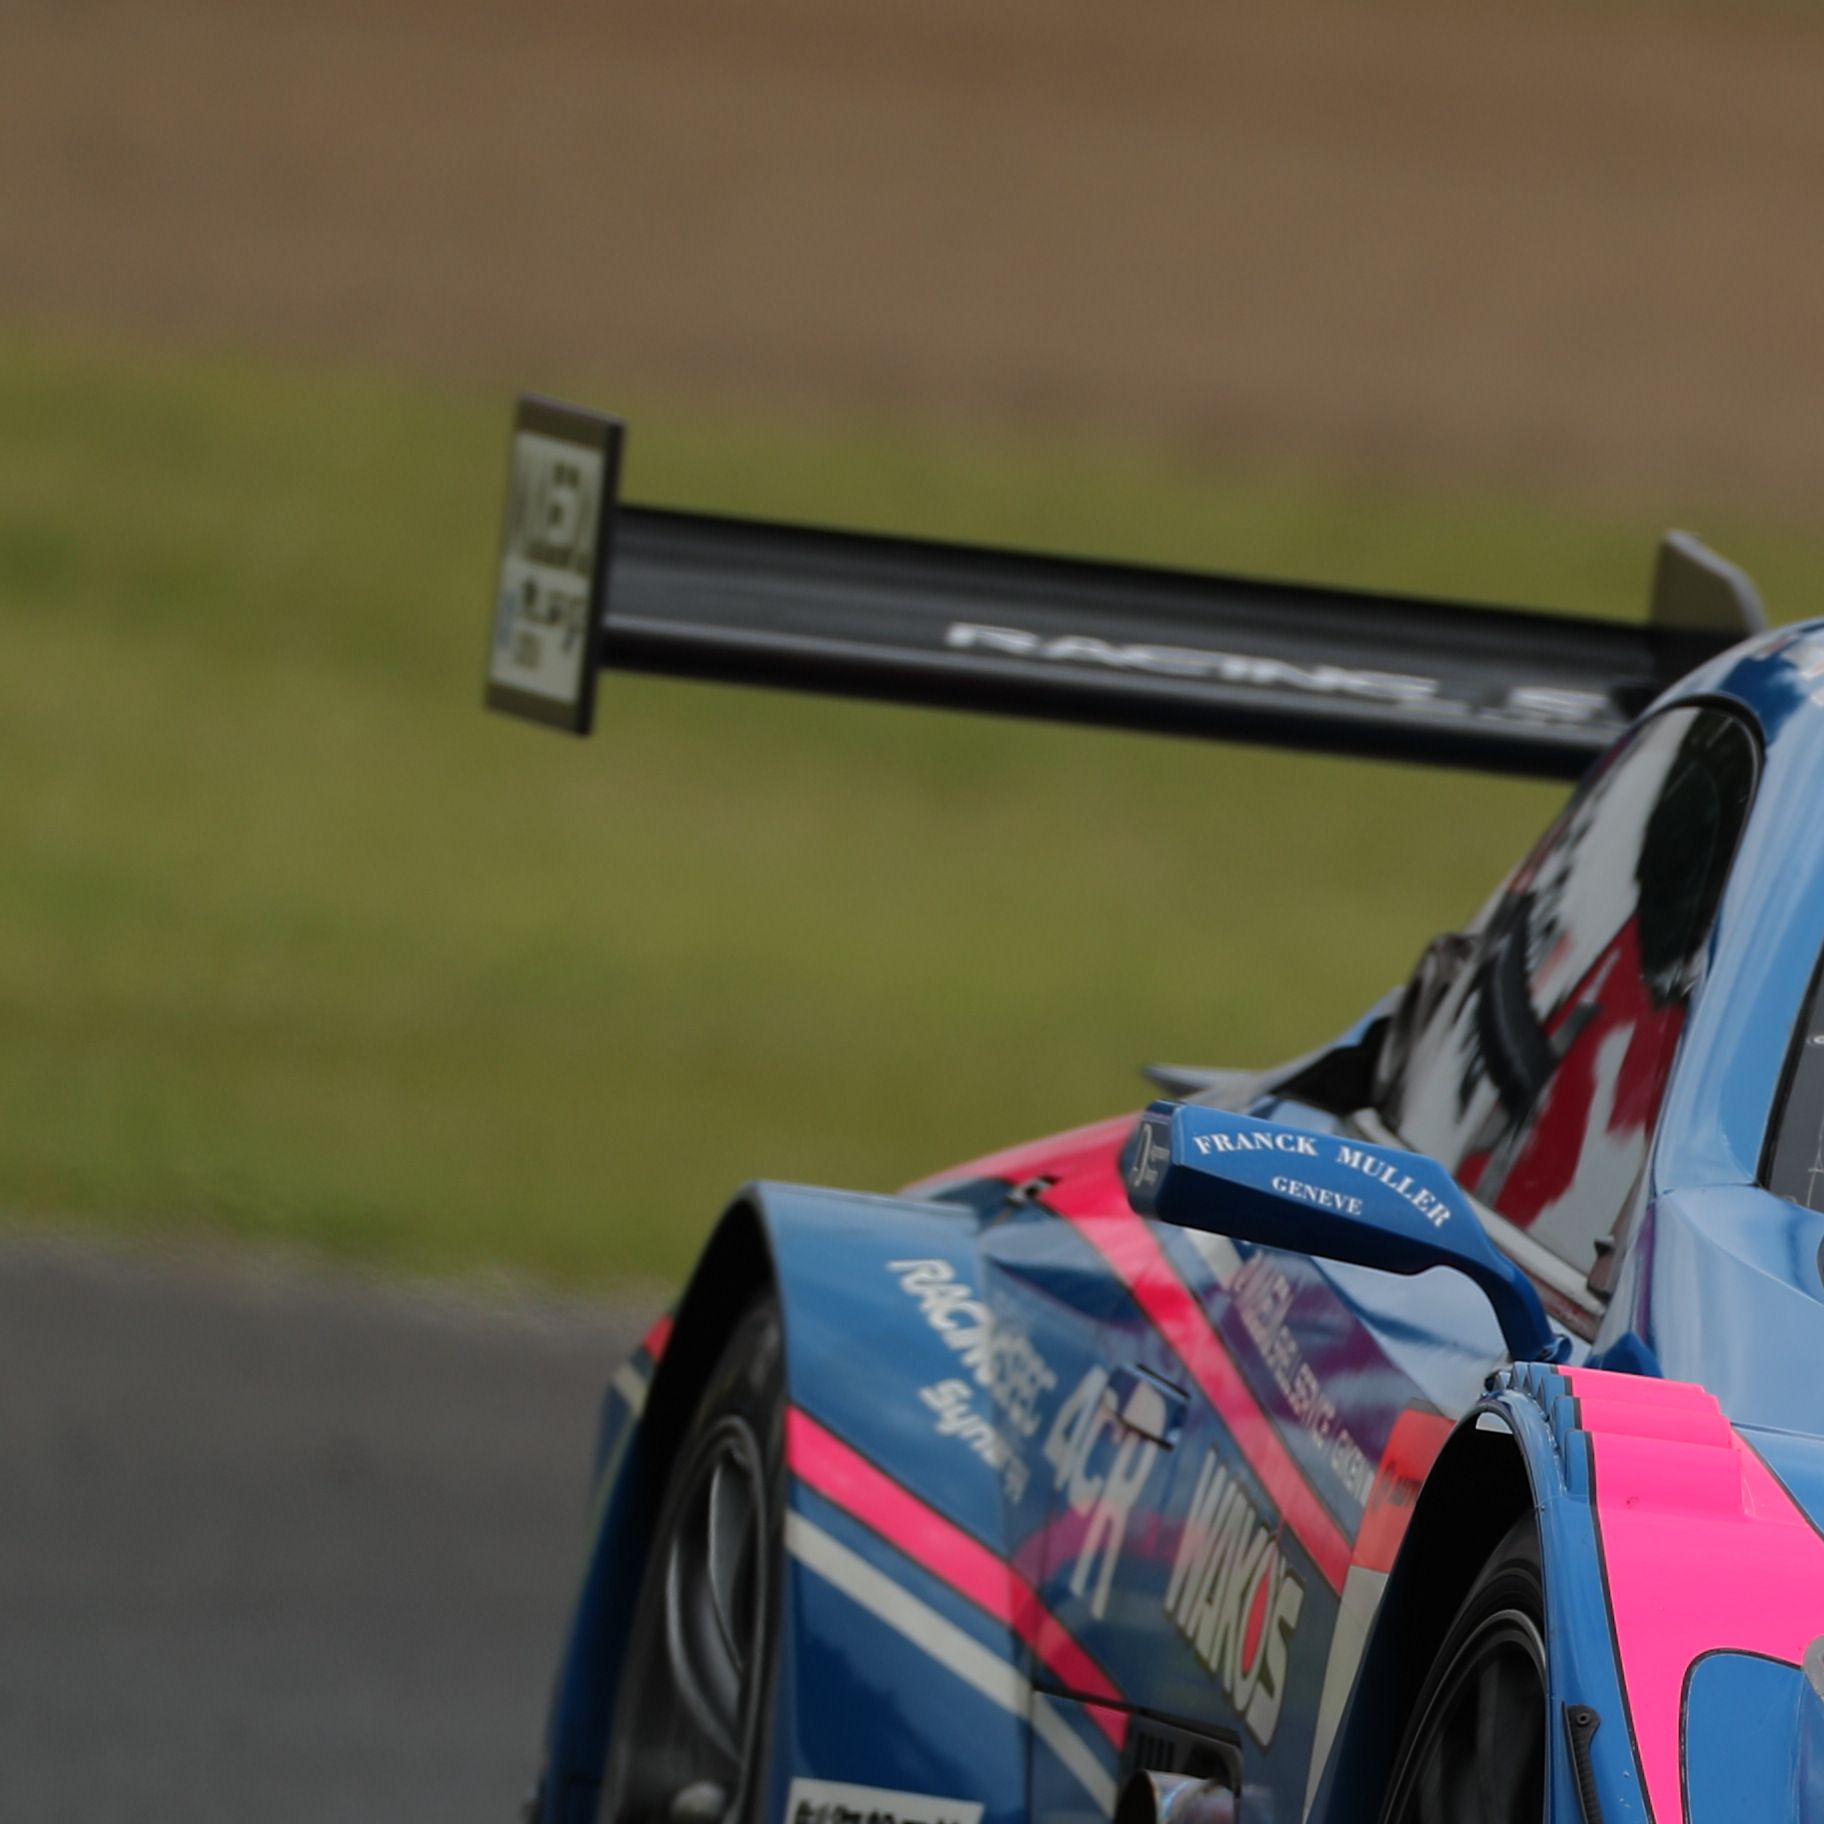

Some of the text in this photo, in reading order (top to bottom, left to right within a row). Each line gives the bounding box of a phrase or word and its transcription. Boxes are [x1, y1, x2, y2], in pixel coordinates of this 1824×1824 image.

[1192, 1131, 1319, 1157] FRANCK
[1335, 1145, 1452, 1229] MULLER
[1271, 1175, 1365, 1217] GENEVE
